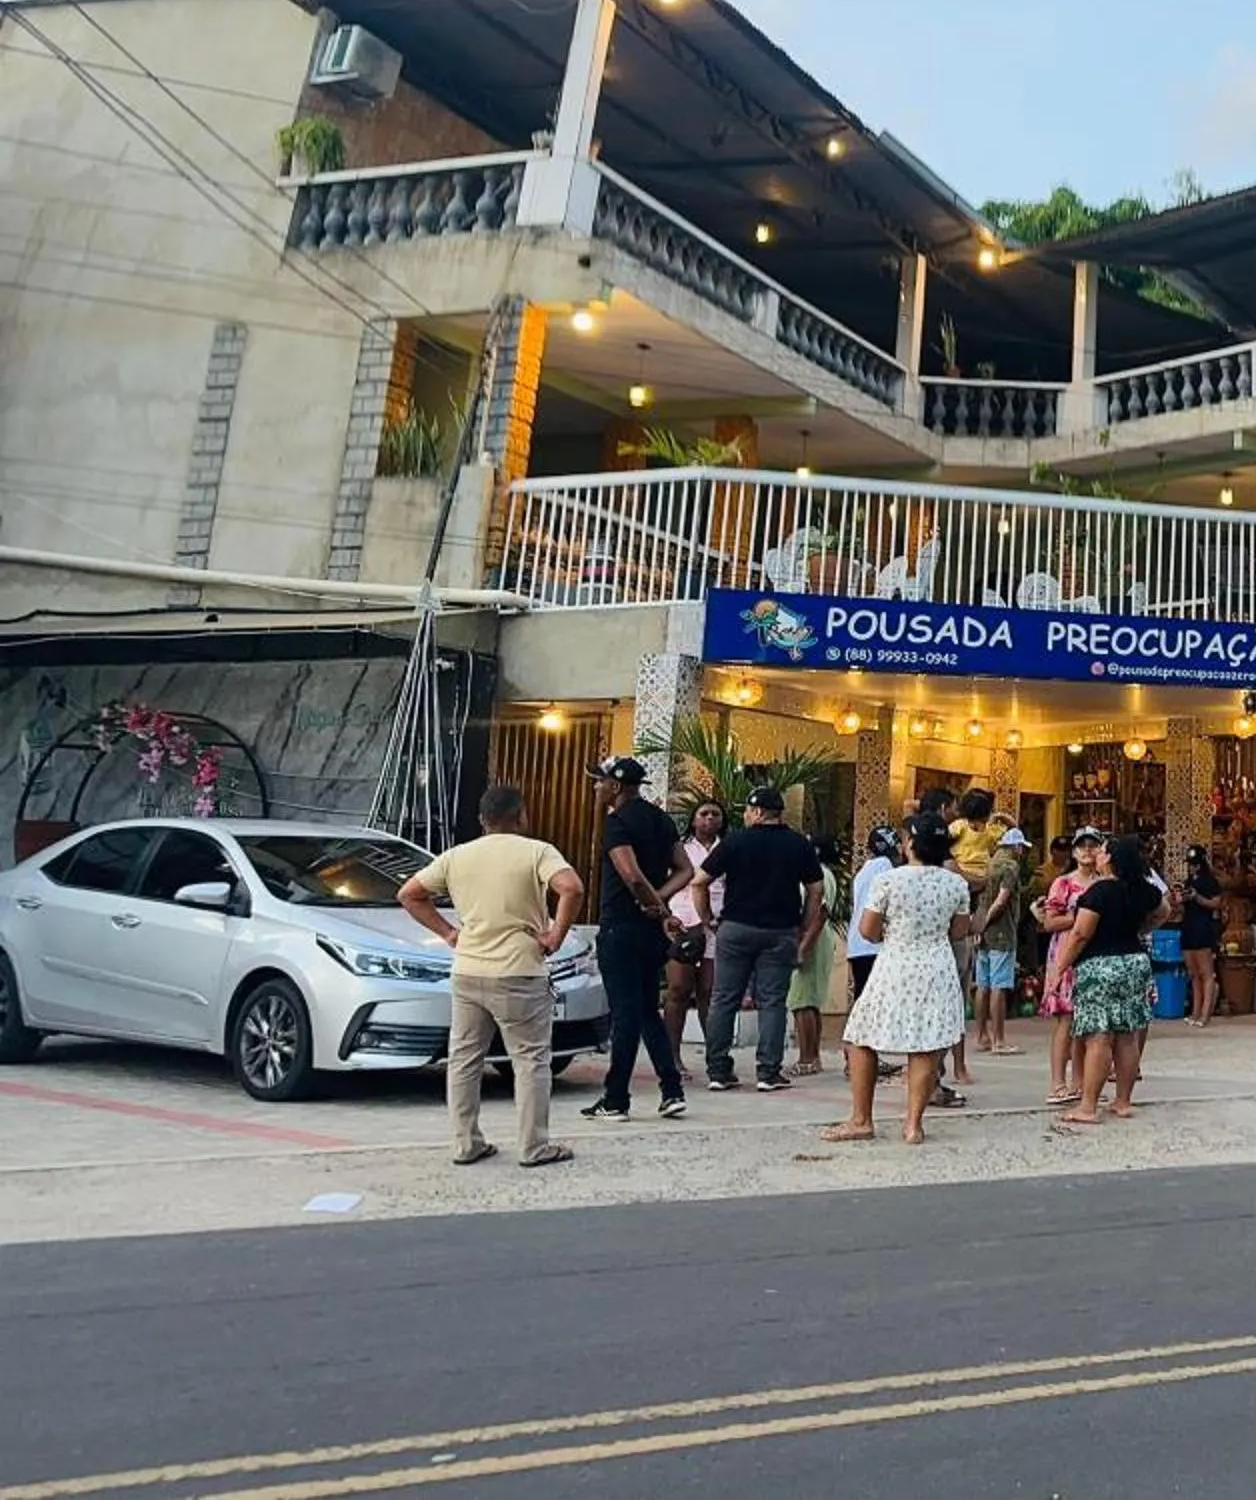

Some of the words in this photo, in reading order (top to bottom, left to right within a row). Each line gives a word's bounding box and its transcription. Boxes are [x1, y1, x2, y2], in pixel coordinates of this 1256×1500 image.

[826, 607, 1013, 649] POUSADA
[845, 647, 873, 663] (88)
[877, 649, 959, 665] 99933-0942
